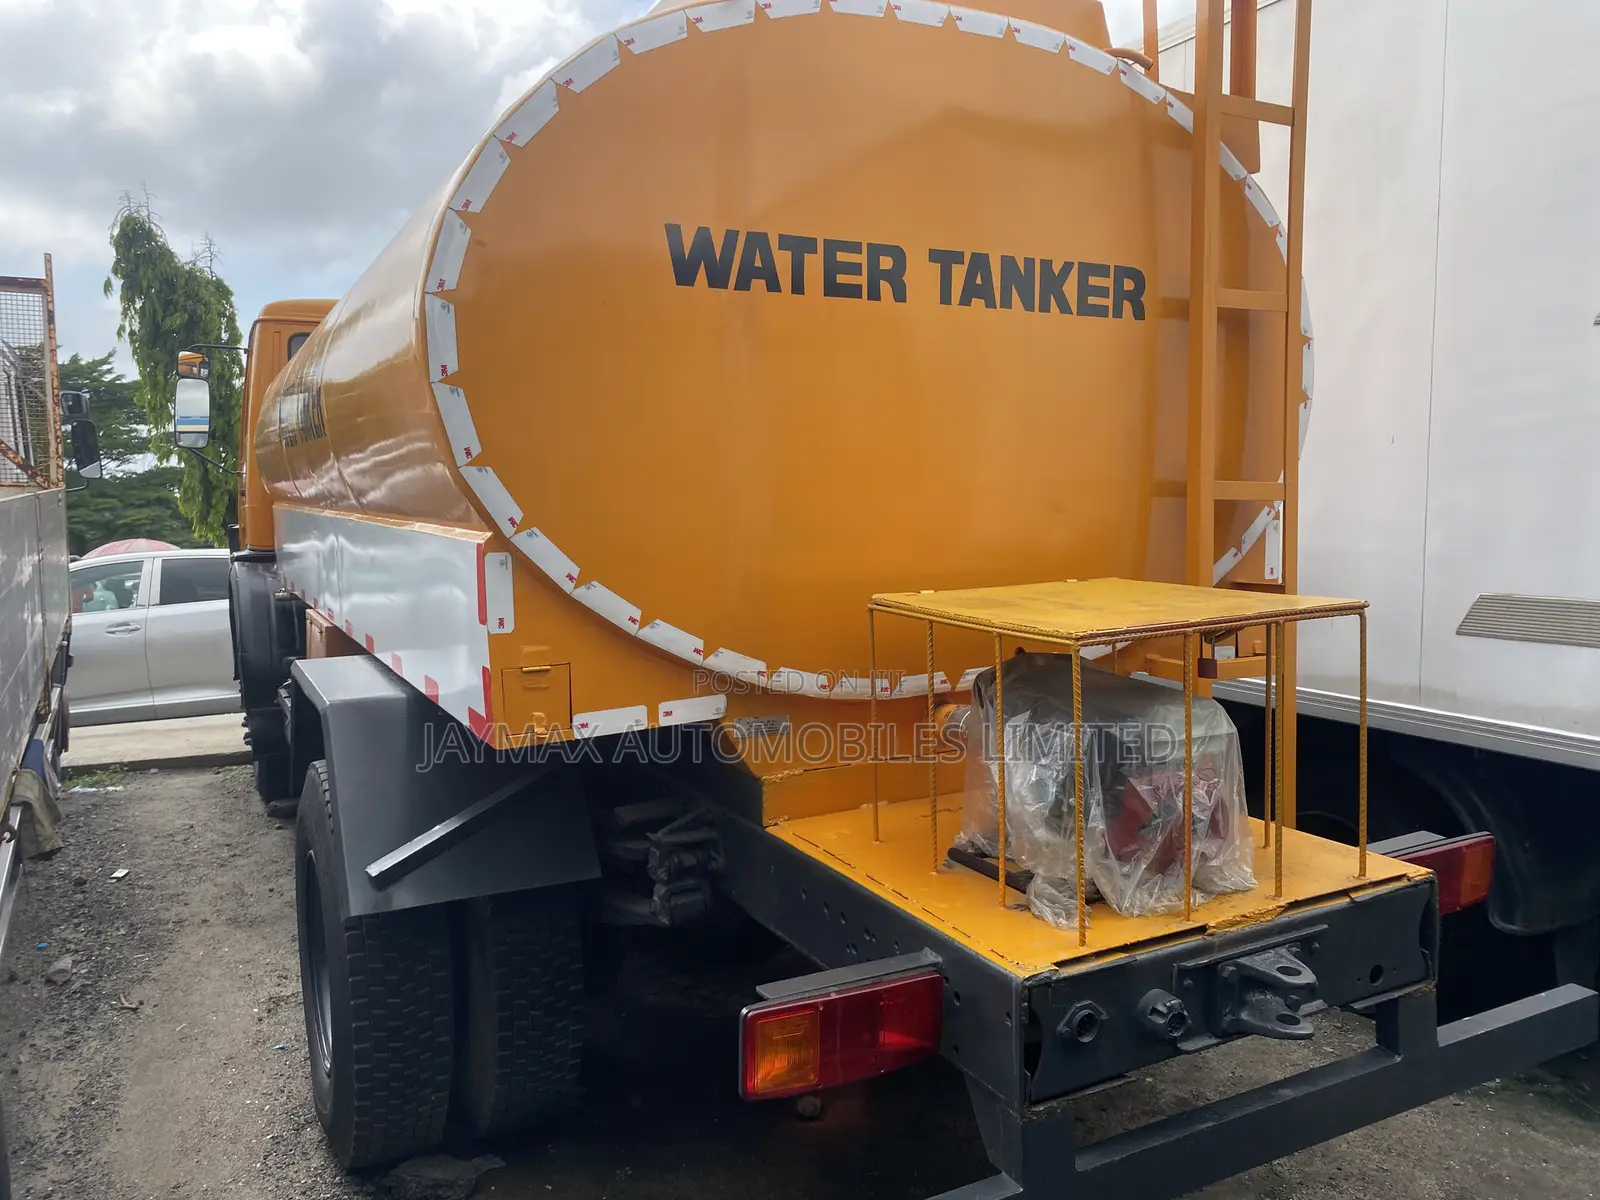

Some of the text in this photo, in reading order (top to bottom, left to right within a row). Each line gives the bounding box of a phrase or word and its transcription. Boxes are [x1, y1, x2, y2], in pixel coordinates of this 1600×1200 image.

[664, 223, 1146, 321] WATER TANKER
[440, 364, 449, 377] 3M
[464, 446, 473, 459] 3M
[507, 516, 519, 528] 3M
[566, 572, 577, 584] 3M
[498, 617, 505, 629] 3M
[628, 615, 640, 626] 3M
[693, 647, 704, 656] 3M
